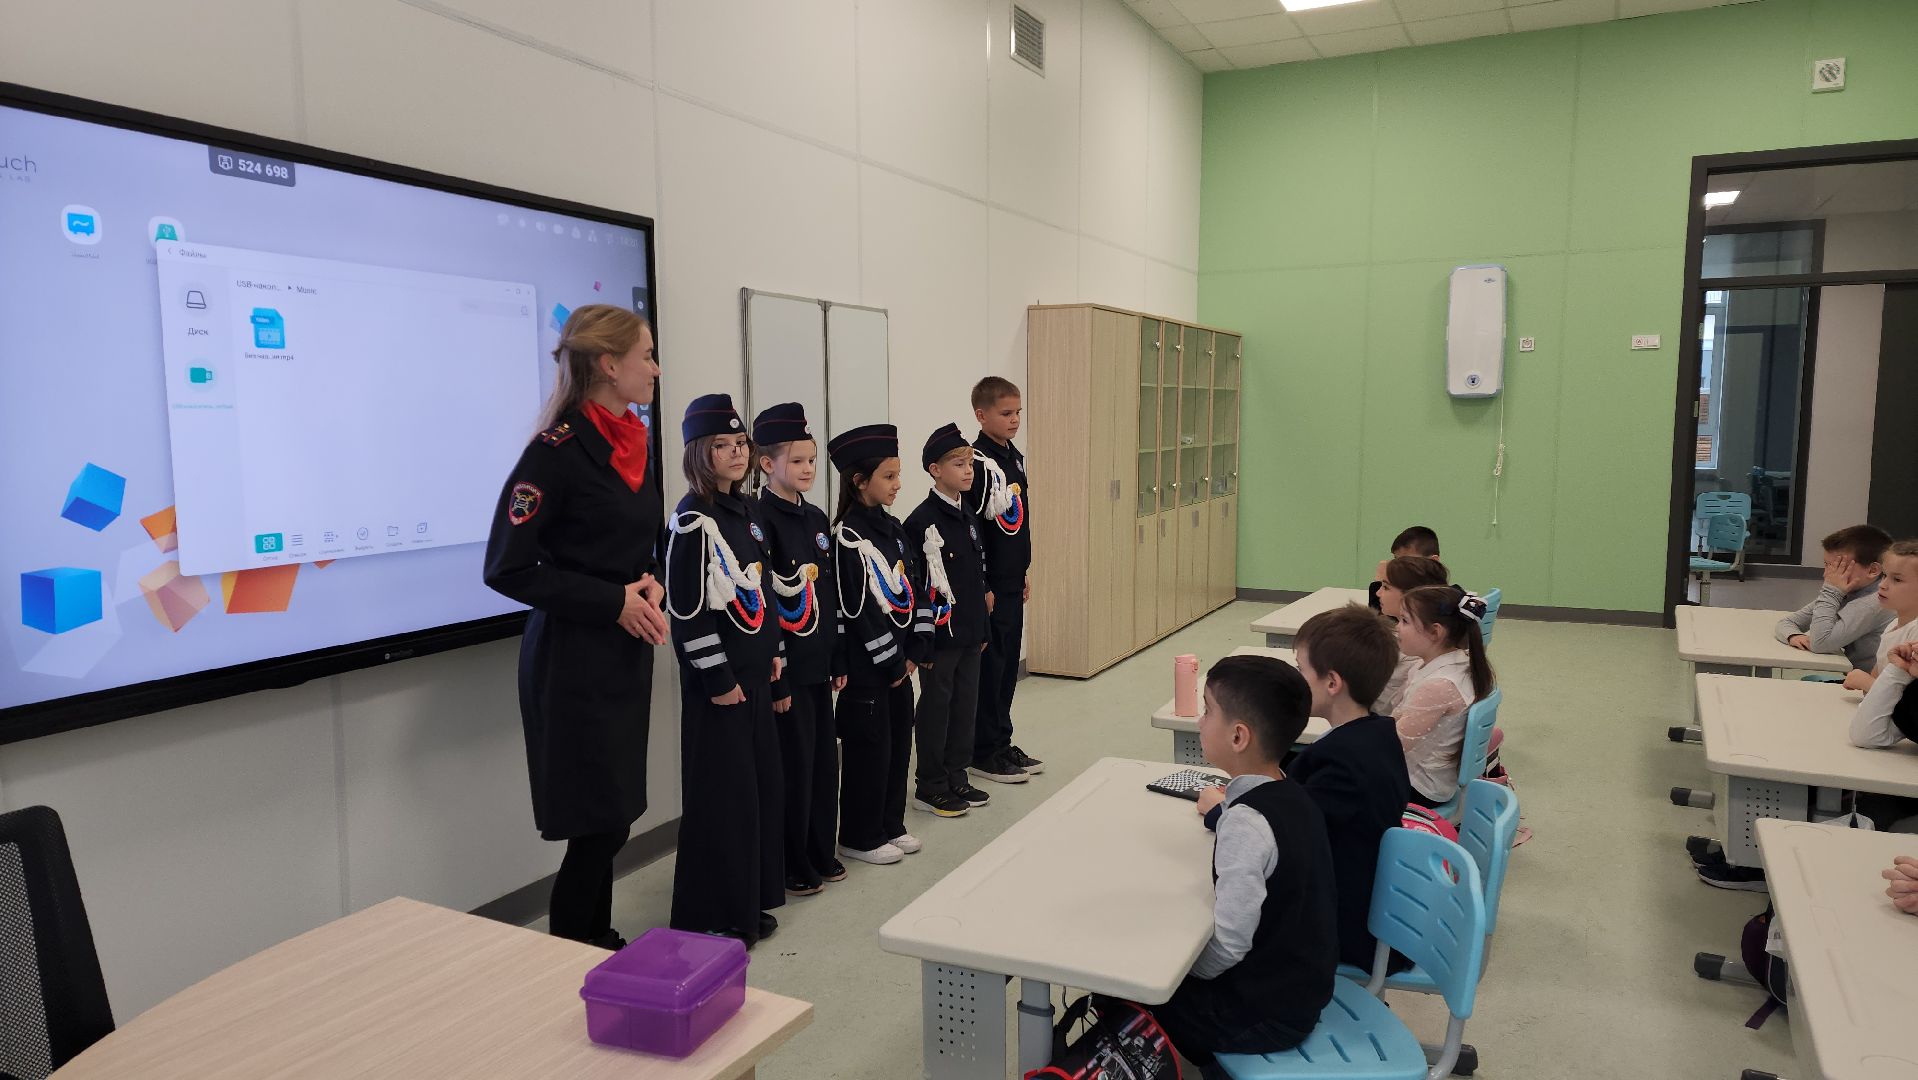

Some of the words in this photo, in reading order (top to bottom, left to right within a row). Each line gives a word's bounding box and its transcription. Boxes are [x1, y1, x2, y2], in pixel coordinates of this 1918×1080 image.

[238, 158, 262, 176] 524
[265, 163, 289, 180] 698
[187, 327, 209, 337] Диск
